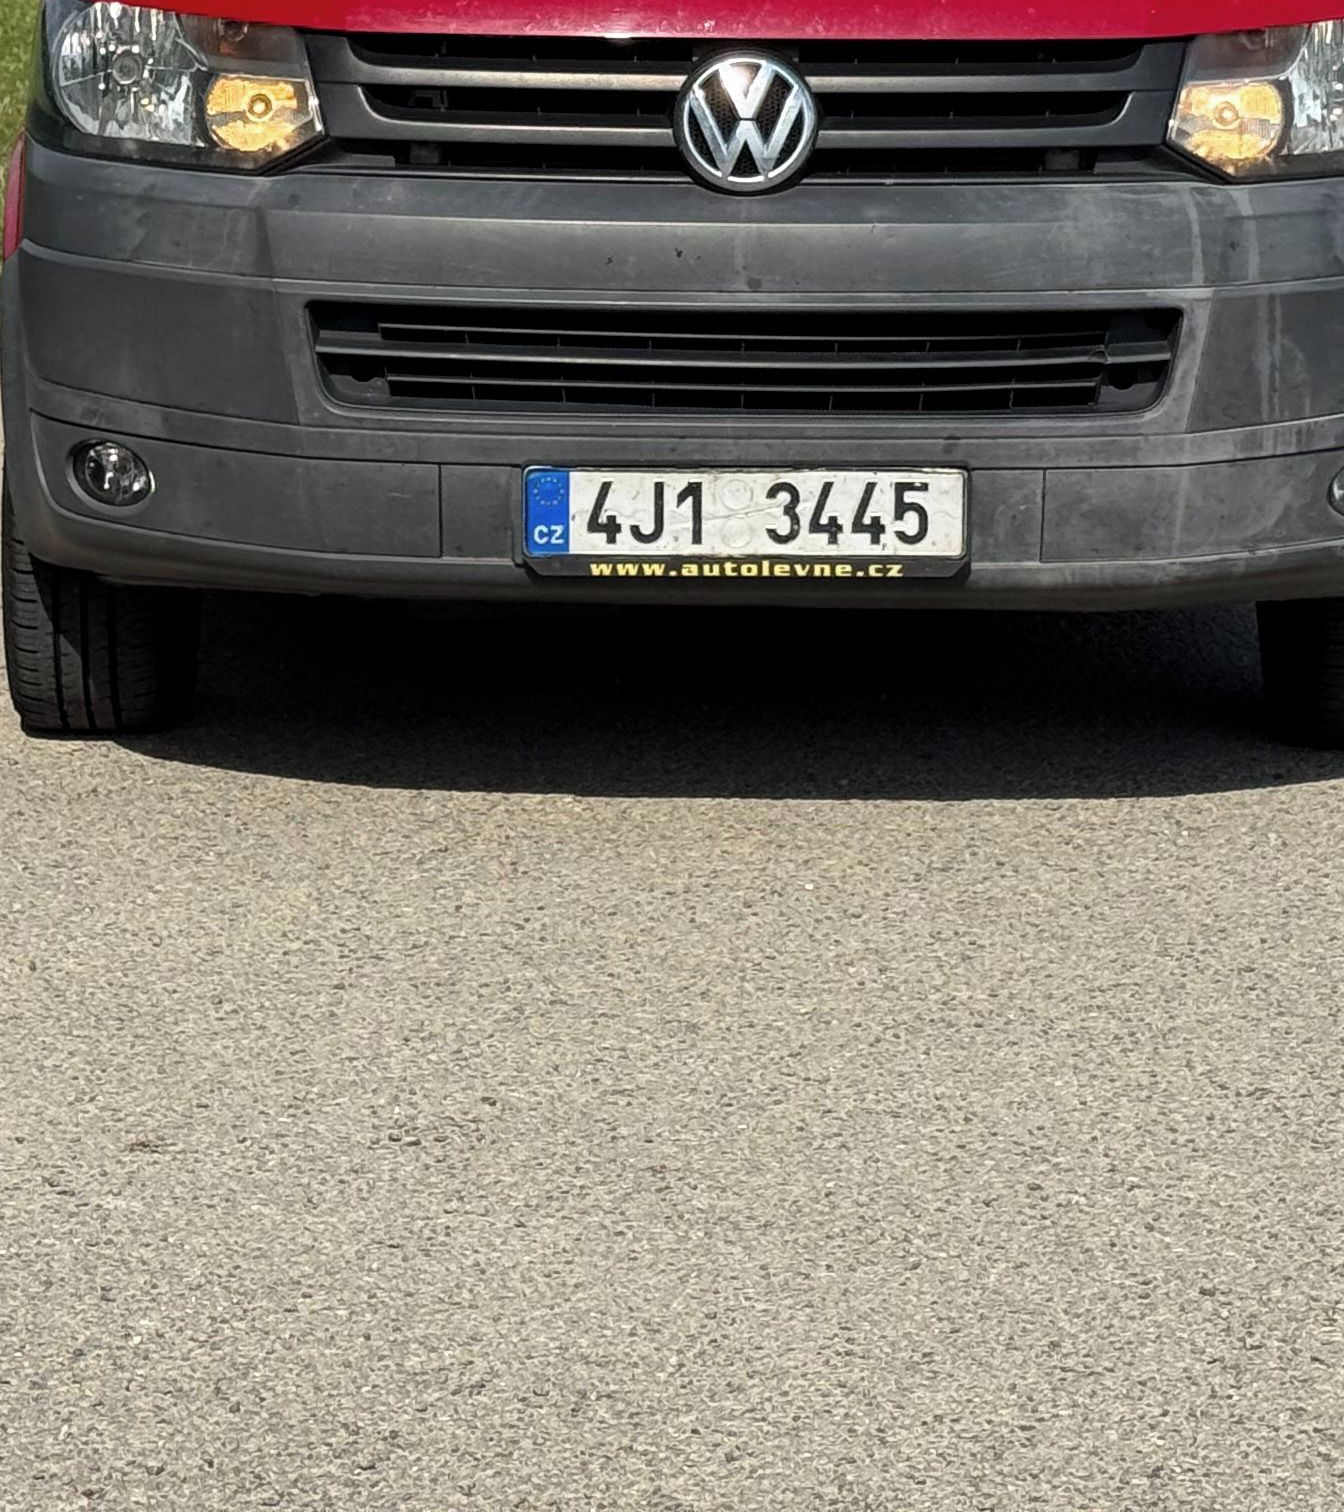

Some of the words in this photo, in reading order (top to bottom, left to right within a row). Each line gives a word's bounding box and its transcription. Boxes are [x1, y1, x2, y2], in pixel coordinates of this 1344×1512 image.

[687, 59, 804, 180] VW
[533, 524, 565, 544] CZ
[586, 481, 703, 545] 4J1
[765, 481, 929, 545] 3445
[589, 560, 904, 578] www.autolevne.cz
